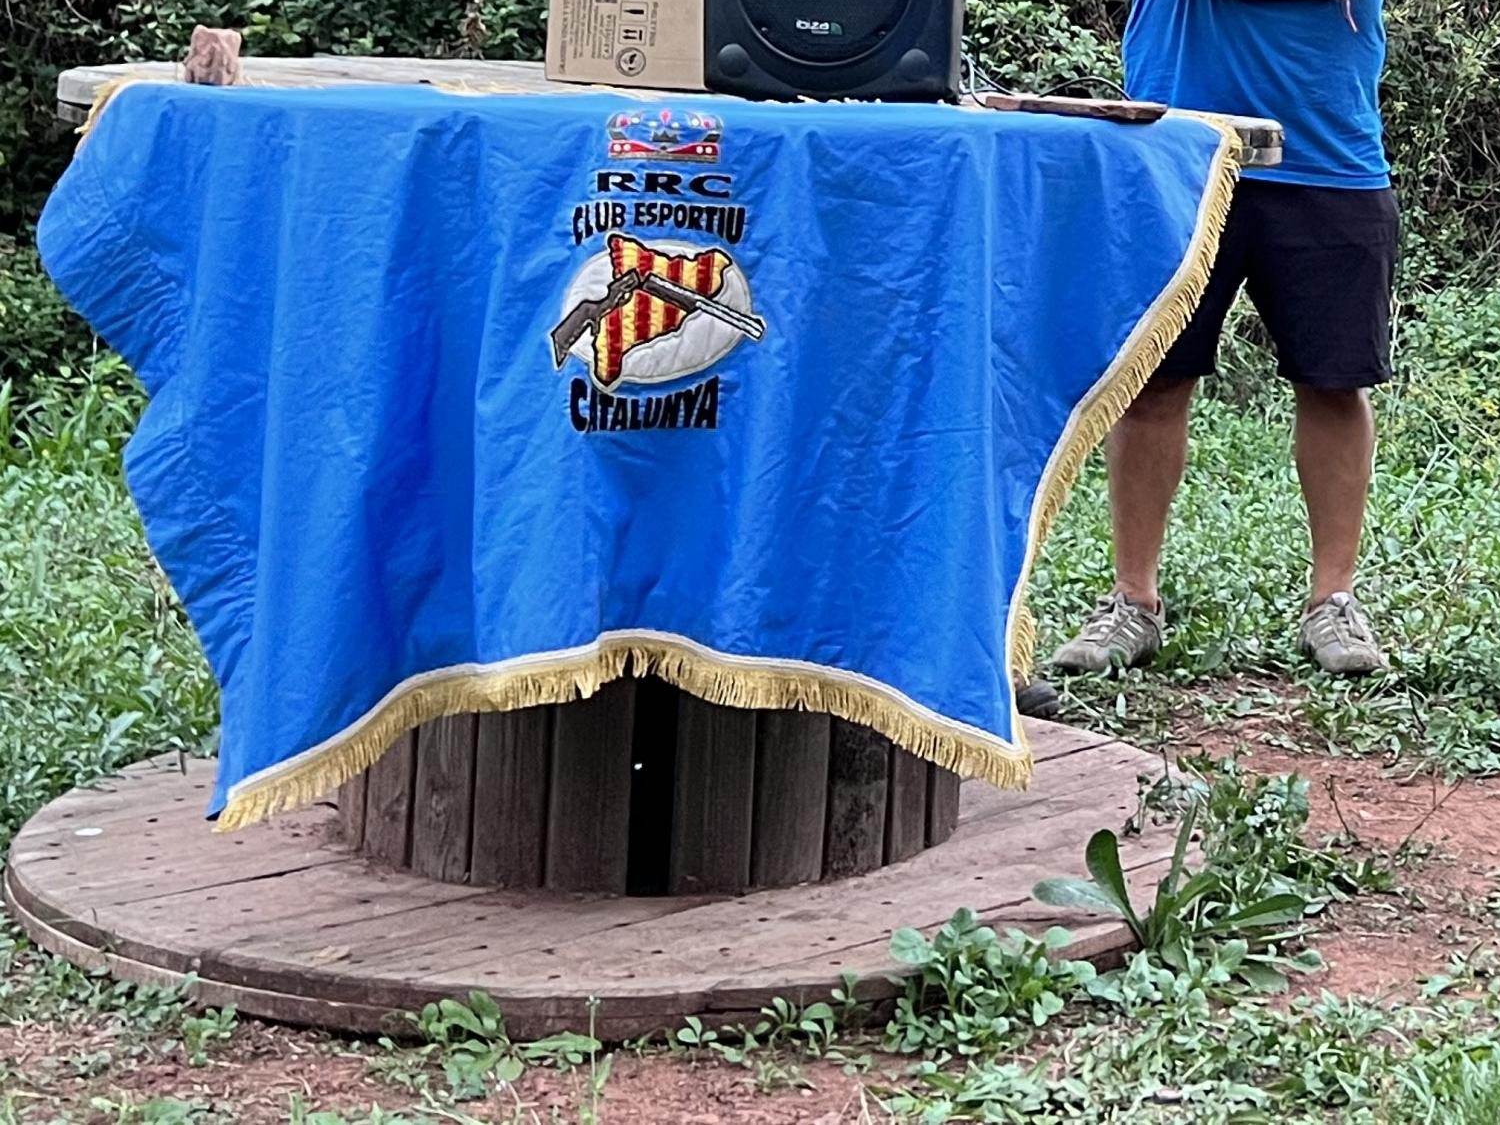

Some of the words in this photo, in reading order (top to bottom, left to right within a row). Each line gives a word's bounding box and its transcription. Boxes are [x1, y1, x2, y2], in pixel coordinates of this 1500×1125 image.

[596, 171, 732, 199] RRC
[572, 203, 627, 246] CLUB
[633, 202, 746, 244] ESPORTIU
[569, 375, 720, 433] CATALUNYA
